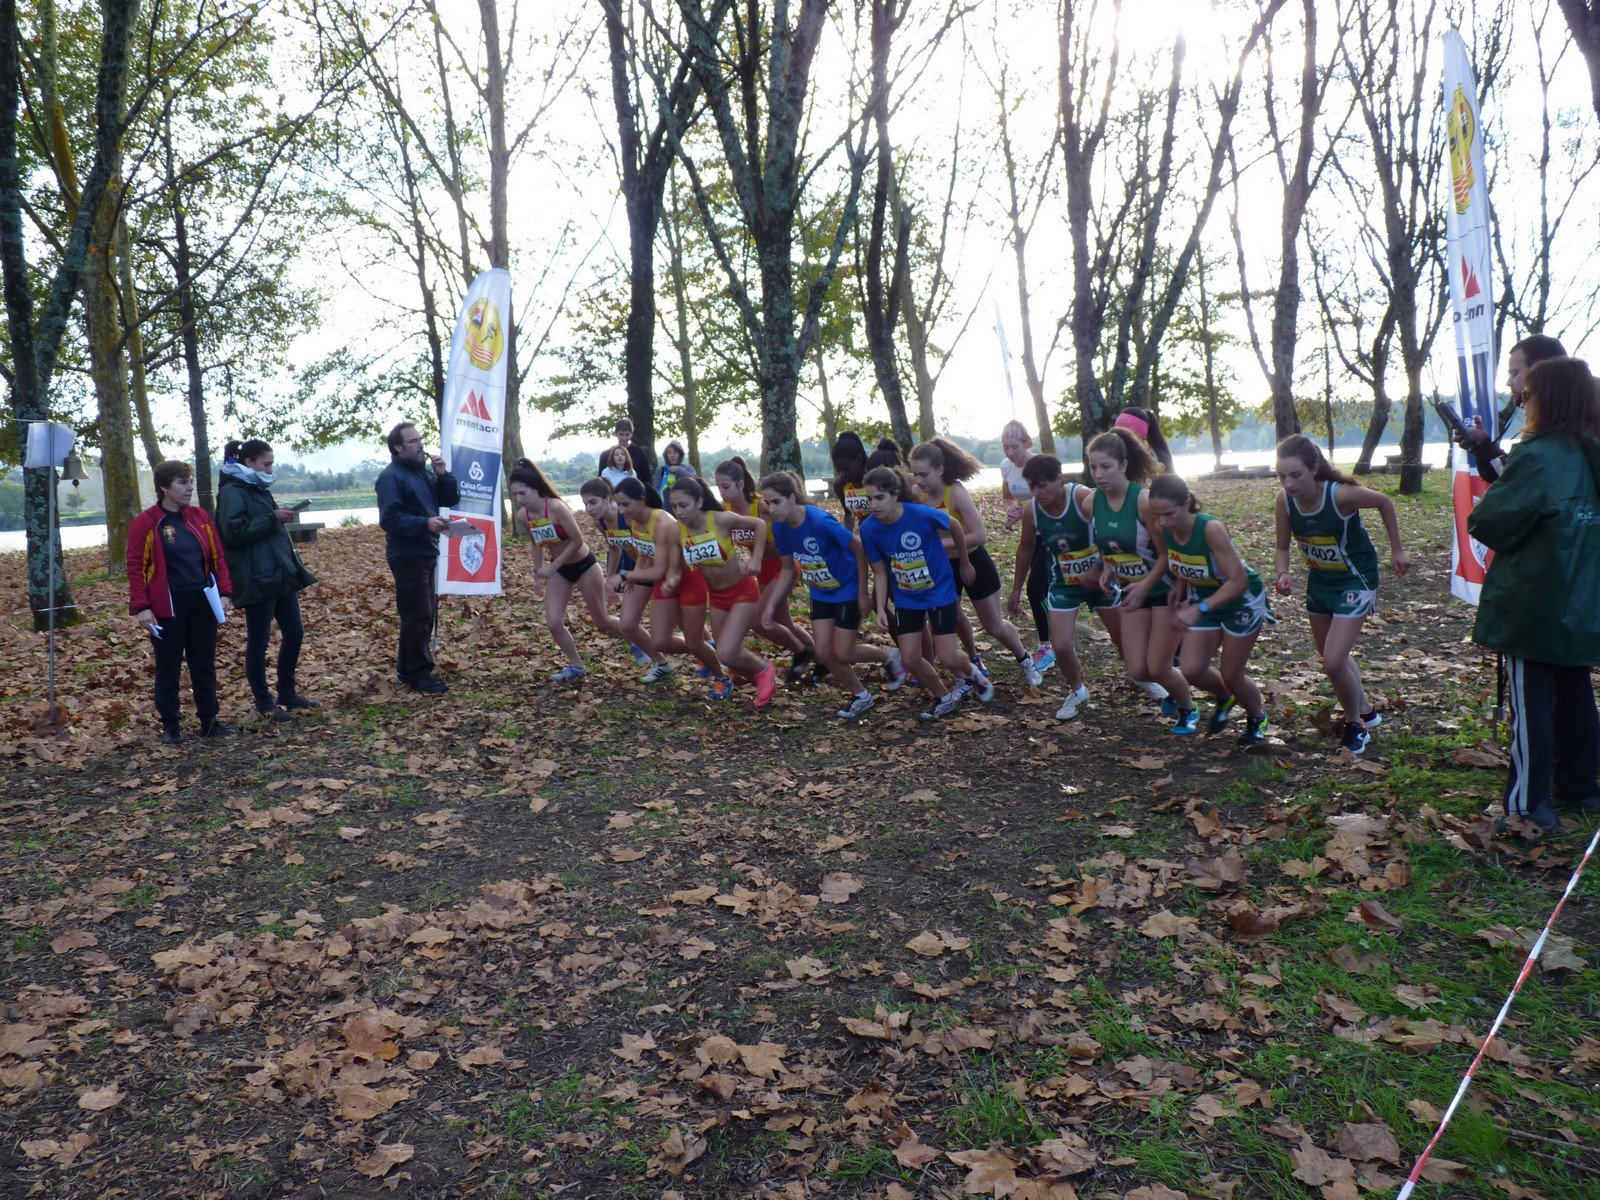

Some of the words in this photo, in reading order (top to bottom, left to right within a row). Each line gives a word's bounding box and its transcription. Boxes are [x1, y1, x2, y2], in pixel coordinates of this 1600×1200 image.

[456, 418, 499, 433] montaco
[460, 480, 476, 490] Caixa
[476, 483, 493, 493] Geral
[686, 544, 717, 562] 7332
[1301, 544, 1339, 562] 7402
[895, 569, 927, 583] 7314
